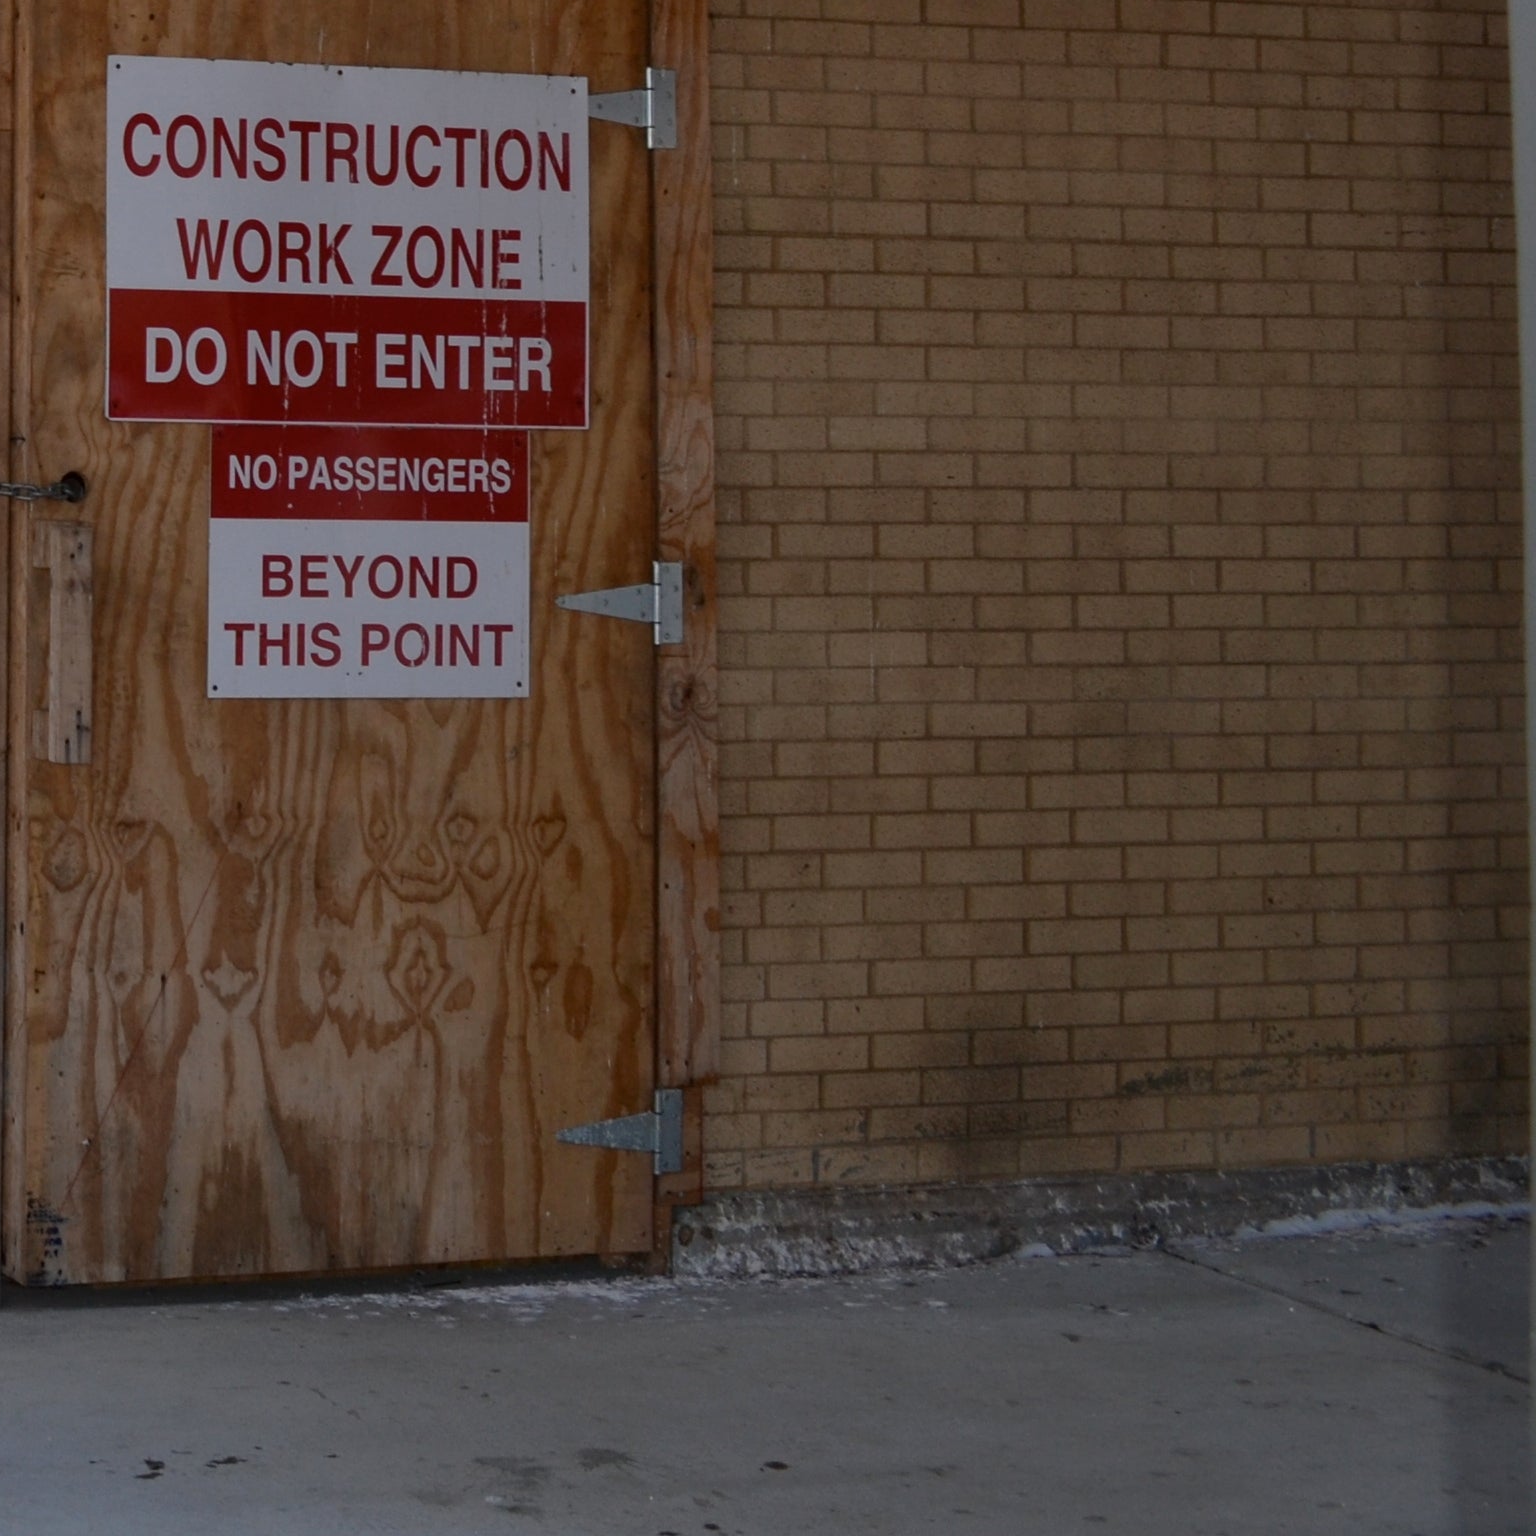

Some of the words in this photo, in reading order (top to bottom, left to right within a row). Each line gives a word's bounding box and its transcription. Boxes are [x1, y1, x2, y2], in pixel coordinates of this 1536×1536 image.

[122, 112, 572, 192] CONSTRUCTION
[176, 218, 354, 285] WORK
[370, 225, 522, 291] ZONE
[145, 327, 227, 386] DO
[247, 330, 358, 389] NOT
[375, 332, 553, 392] ENTER
[229, 454, 277, 490] NO
[288, 456, 512, 494] PASSENGERS
[261, 554, 478, 599] BEYOND
[224, 622, 342, 667] THIS
[361, 622, 514, 667] POINT
